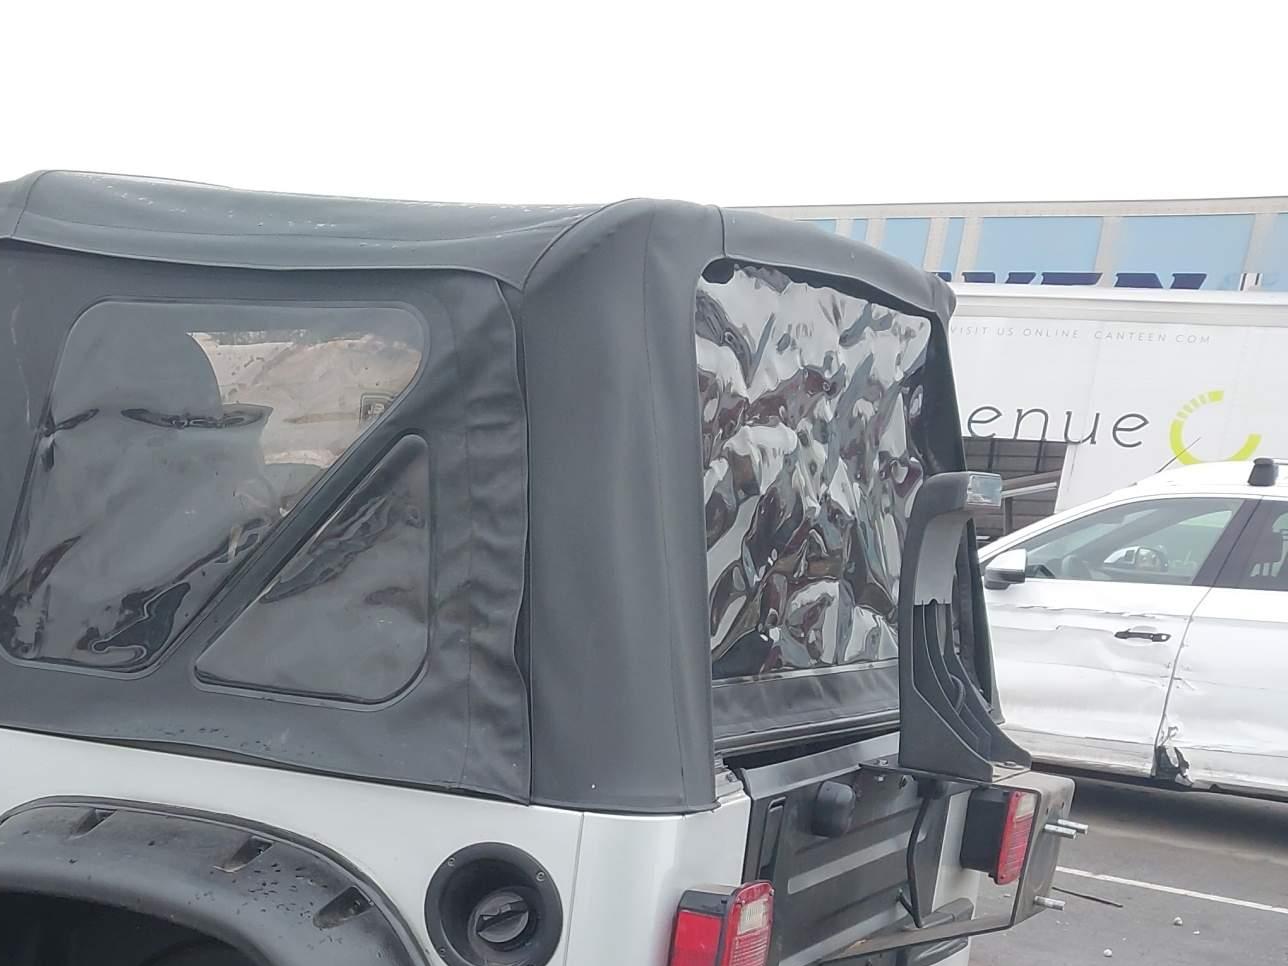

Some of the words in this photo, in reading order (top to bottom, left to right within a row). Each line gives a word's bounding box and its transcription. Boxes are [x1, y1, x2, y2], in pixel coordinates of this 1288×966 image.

[950, 326, 988, 336] VISIT
[996, 326, 1015, 337] US
[1022, 327, 1080, 340] ONLINE
